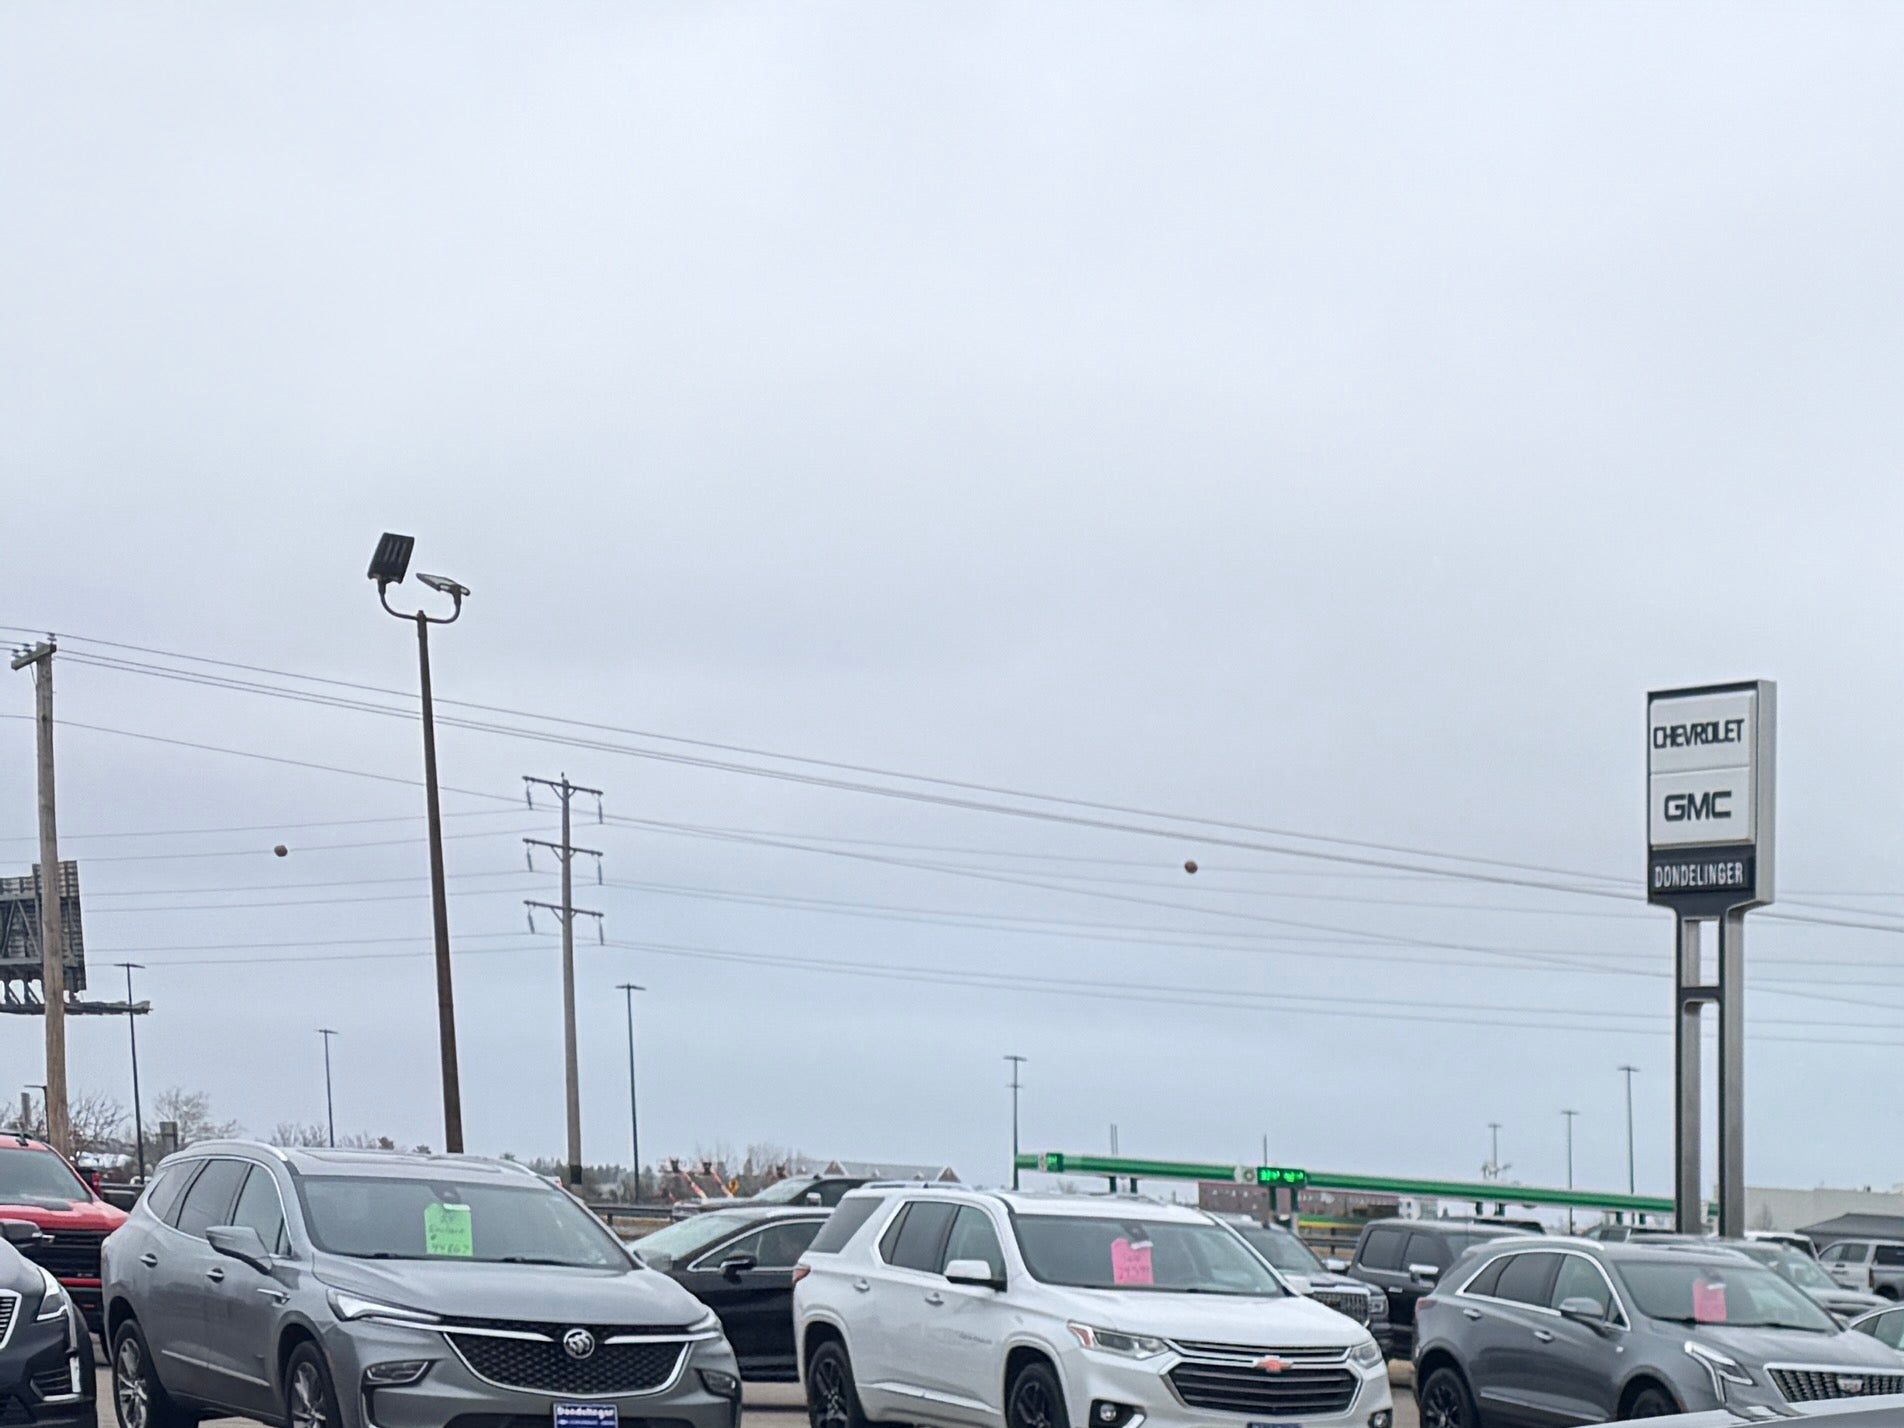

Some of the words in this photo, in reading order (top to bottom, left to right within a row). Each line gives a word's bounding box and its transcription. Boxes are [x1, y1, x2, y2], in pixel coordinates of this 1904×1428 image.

[1653, 718, 1745, 749] CHEVROLET
[1664, 790, 1732, 821] GMC
[1654, 862, 1744, 888] DONDELINGER
